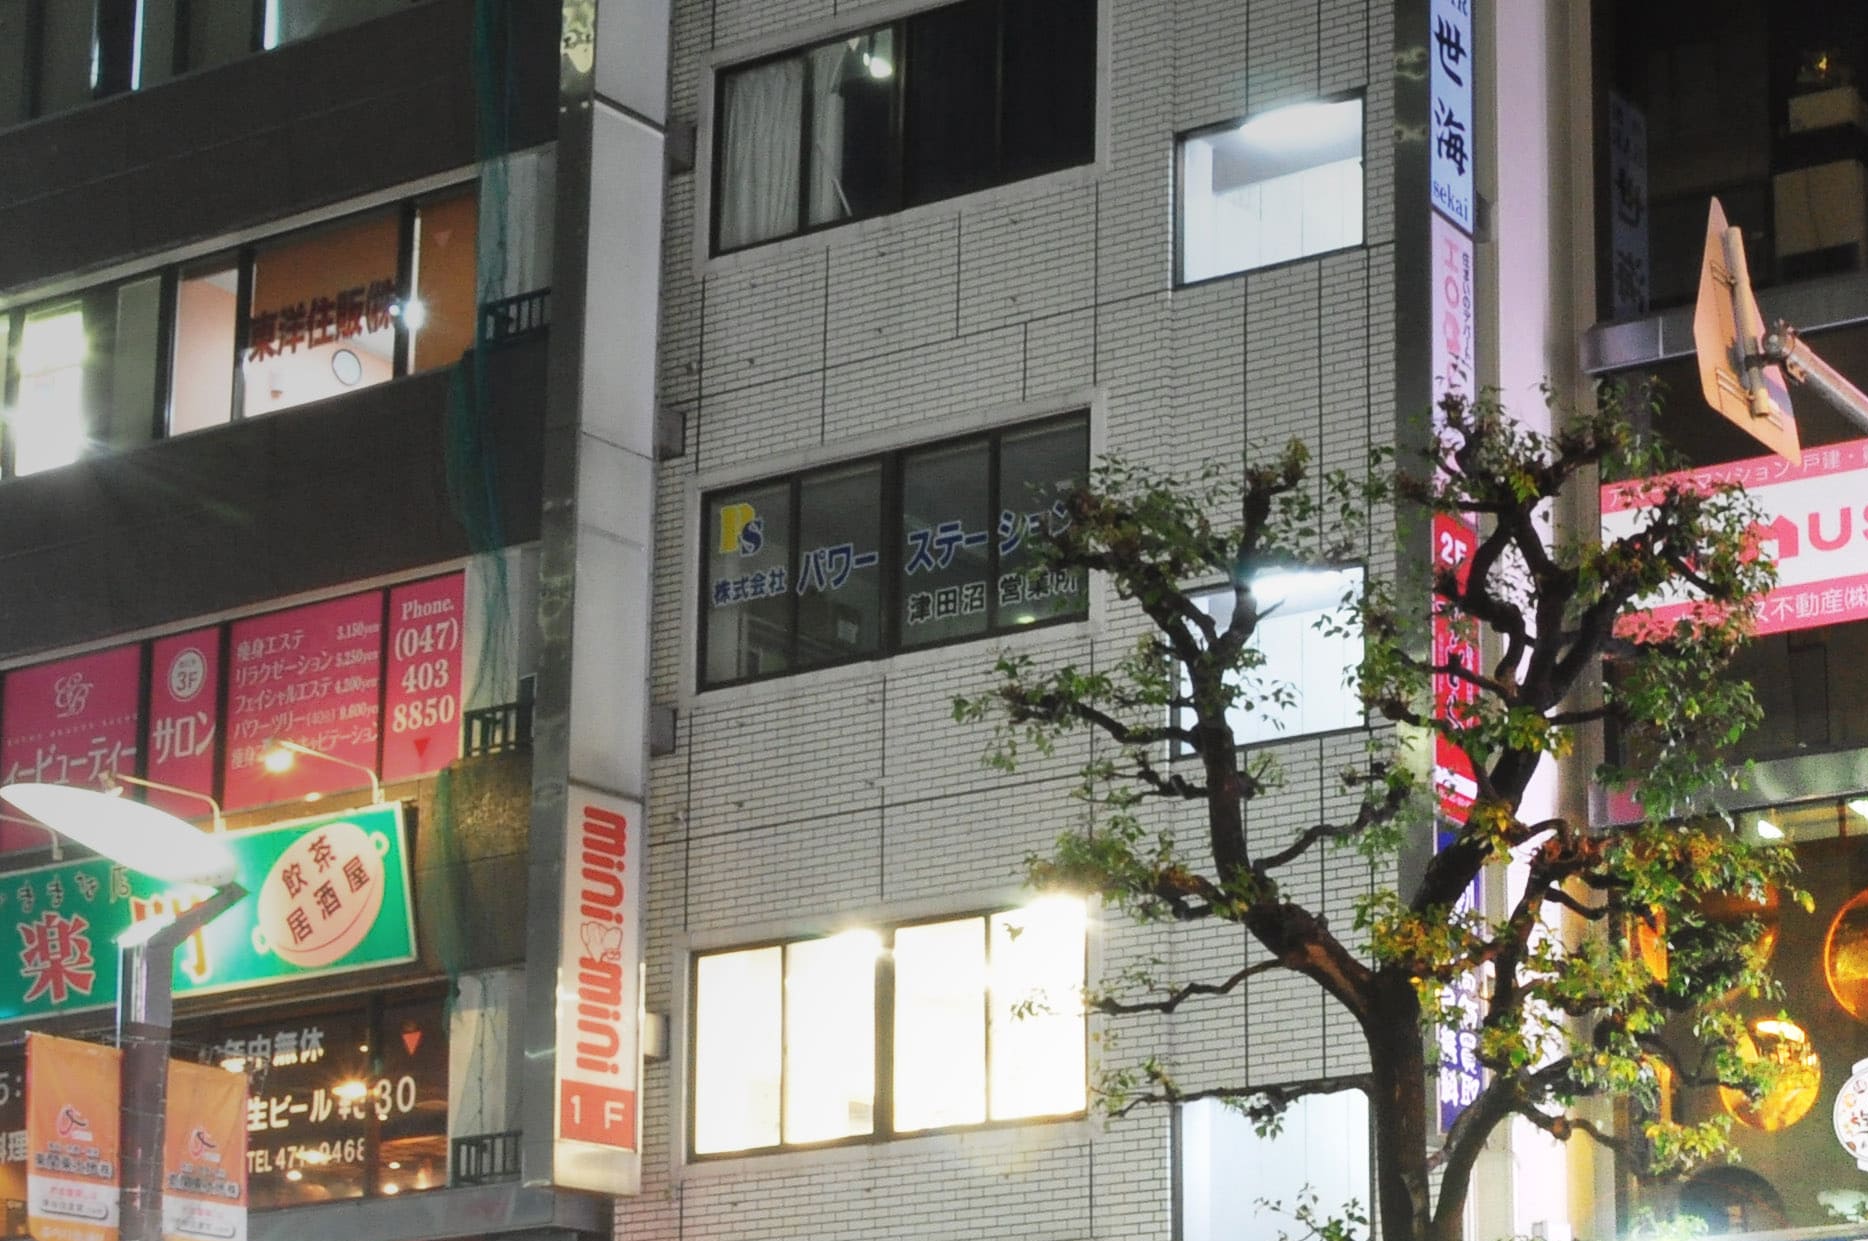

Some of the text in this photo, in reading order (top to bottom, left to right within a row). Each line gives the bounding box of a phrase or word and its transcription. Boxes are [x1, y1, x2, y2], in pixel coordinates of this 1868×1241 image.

[1432, 180, 1469, 221] sekai
[1441, 531, 1467, 566] 2F
[713, 565, 787, 606] 株式会社
[401, 599, 454, 621] Phone.
[394, 617, 459, 661] (047)
[176, 669, 198, 692] 3F
[235, 651, 335, 688] リラクゼーション
[402, 659, 449, 693] 403
[391, 695, 455, 734] 8850
[152, 711, 217, 766] サロン
[281, 834, 338, 899] 飲茶
[286, 855, 372, 945] 居酒屋
[576, 805, 627, 1077] mini mini
[247, 1085, 333, 1131] 生ビール
[247, 1150, 272, 1173] TEL
